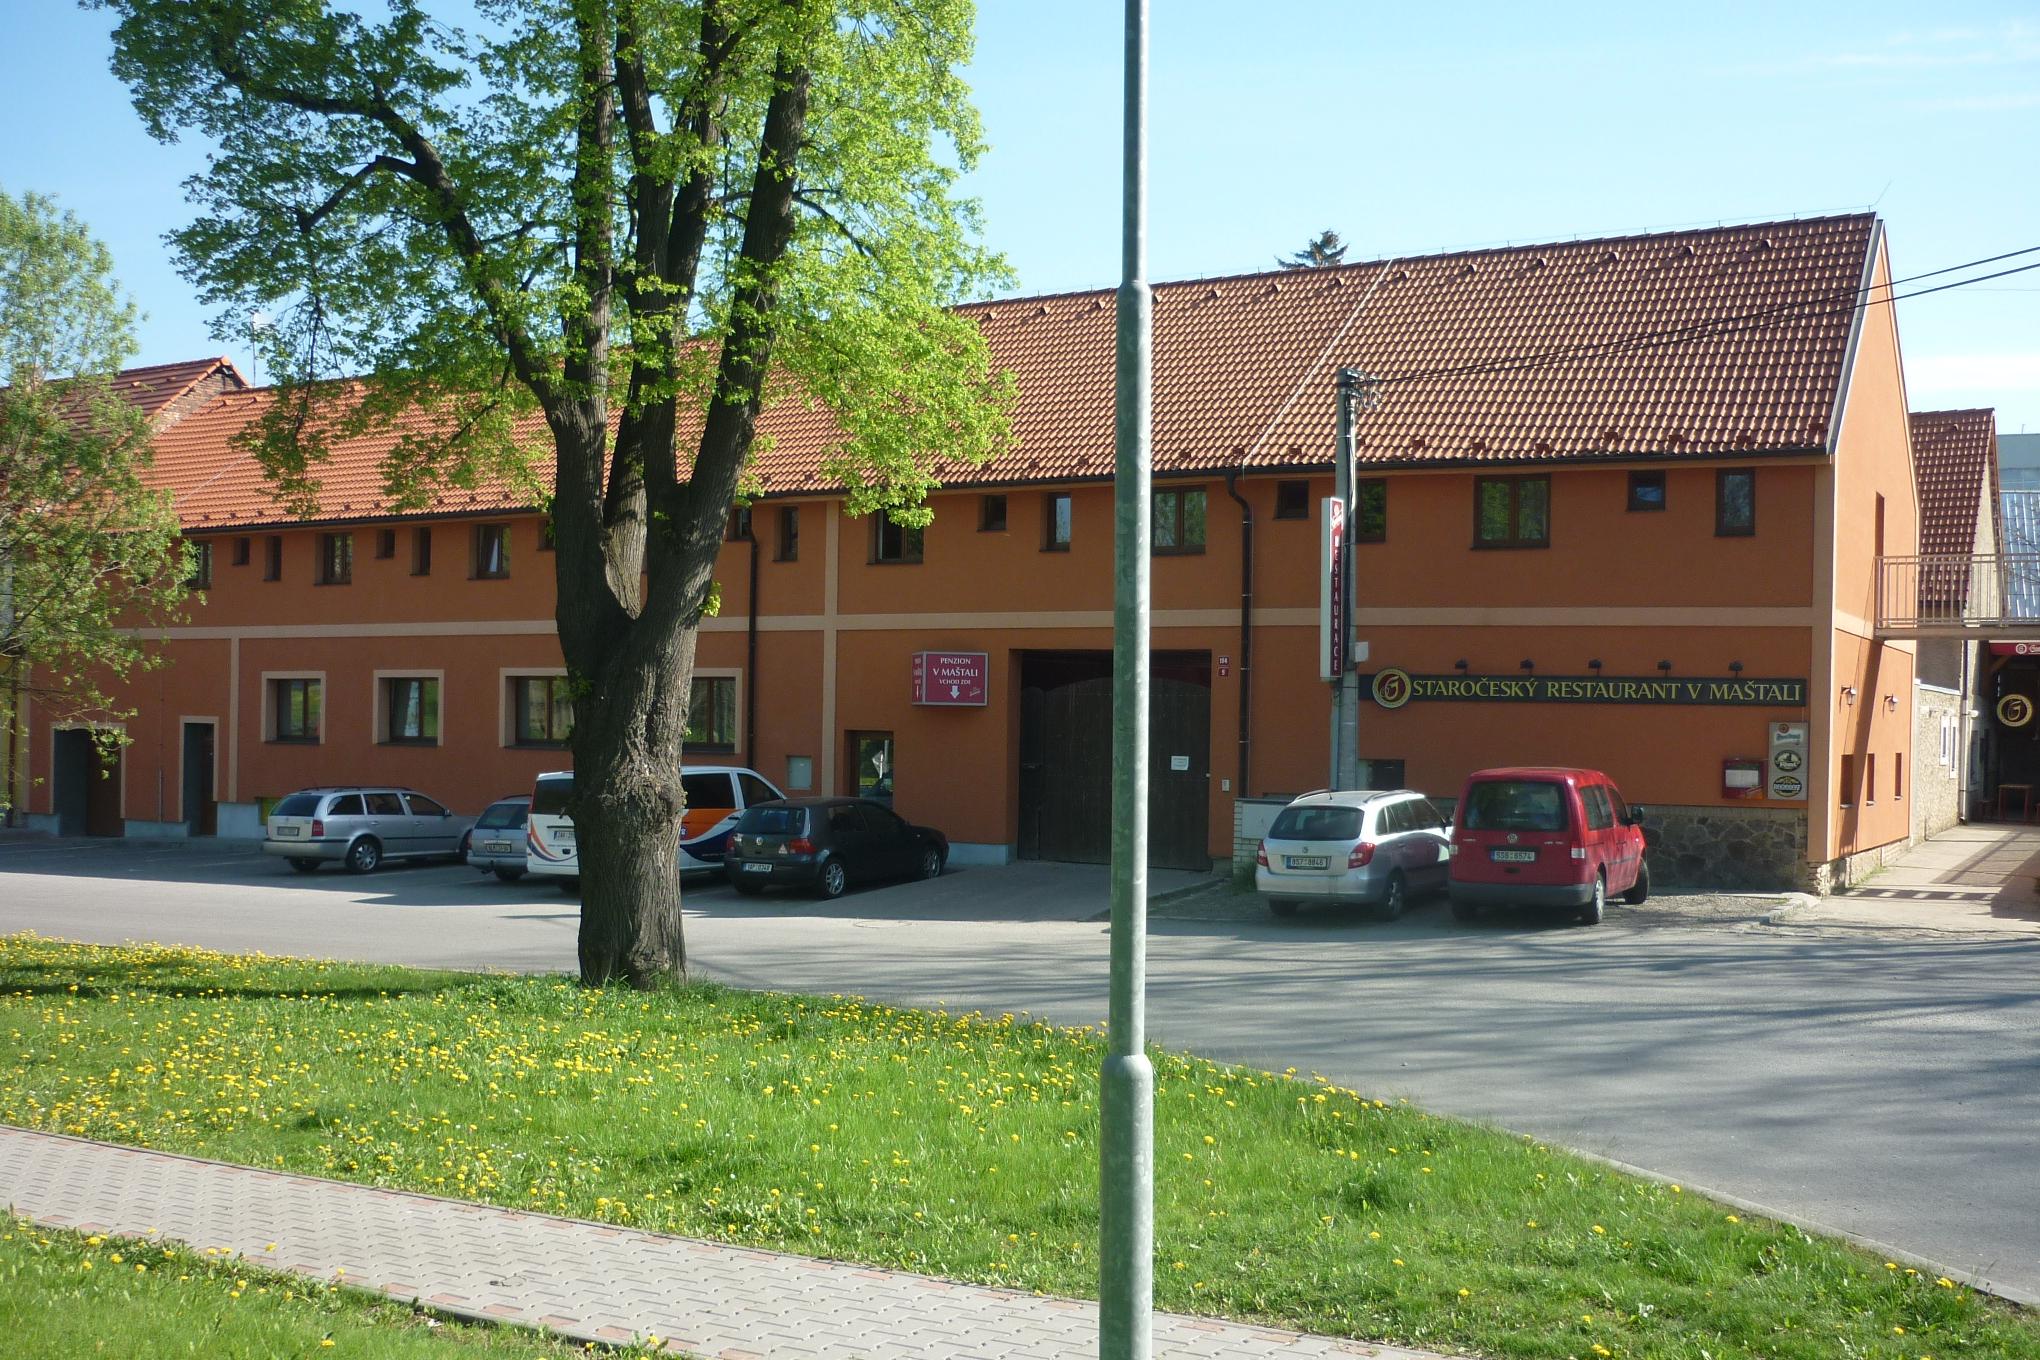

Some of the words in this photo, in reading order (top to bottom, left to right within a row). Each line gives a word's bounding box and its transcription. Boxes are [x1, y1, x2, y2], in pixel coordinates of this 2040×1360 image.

[1333, 535, 1341, 671] ESTAURACE
[940, 657, 971, 665] PENZION
[933, 668, 940, 676] V
[941, 666, 978, 677] MAŠTALI
[1413, 677, 1538, 697] STAROČESKÝ
[1547, 681, 1681, 699] RESTAURANT
[1686, 683, 1702, 699] V
[1709, 681, 1801, 701] MAŠTALI
